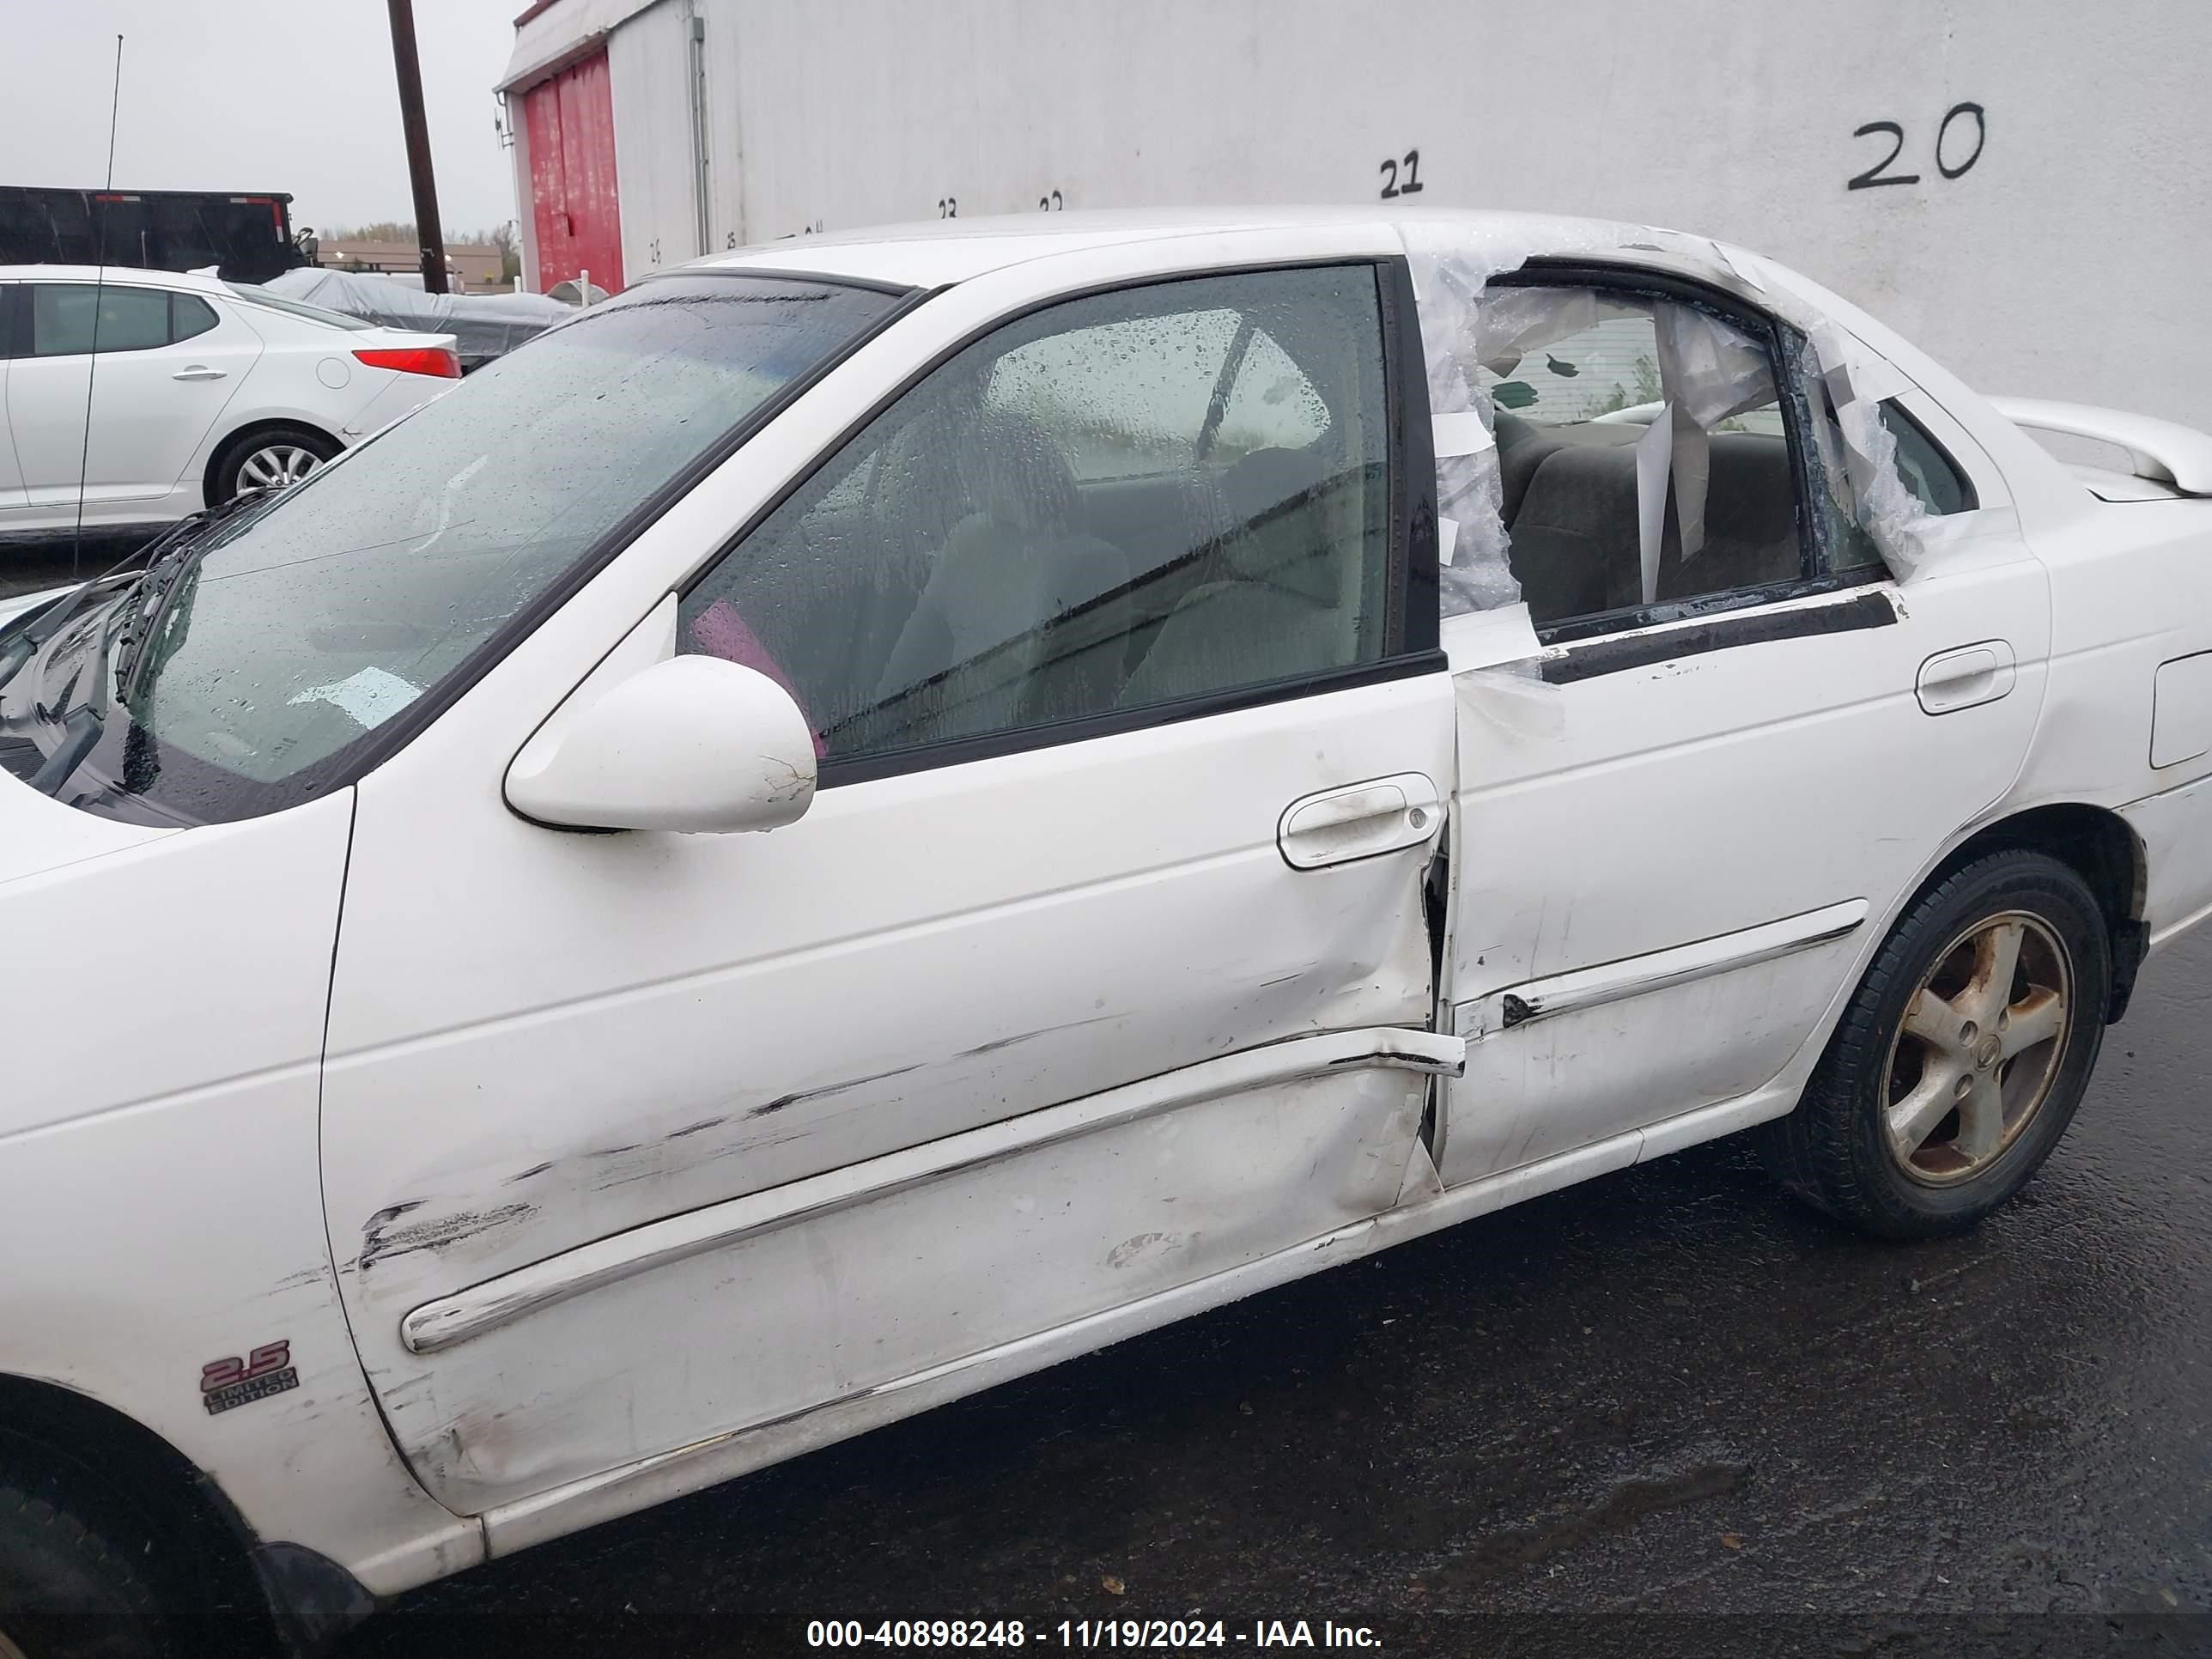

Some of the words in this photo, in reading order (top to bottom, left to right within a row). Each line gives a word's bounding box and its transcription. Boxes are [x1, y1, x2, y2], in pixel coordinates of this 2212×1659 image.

[1847, 101, 1985, 191] 20
[1380, 150, 1424, 198] 21
[650, 238, 661, 264] 26
[201, 1340, 290, 1393] 2.5
[207, 1370, 294, 1404] LIMITED
[209, 1378, 298, 1413] EDITION
